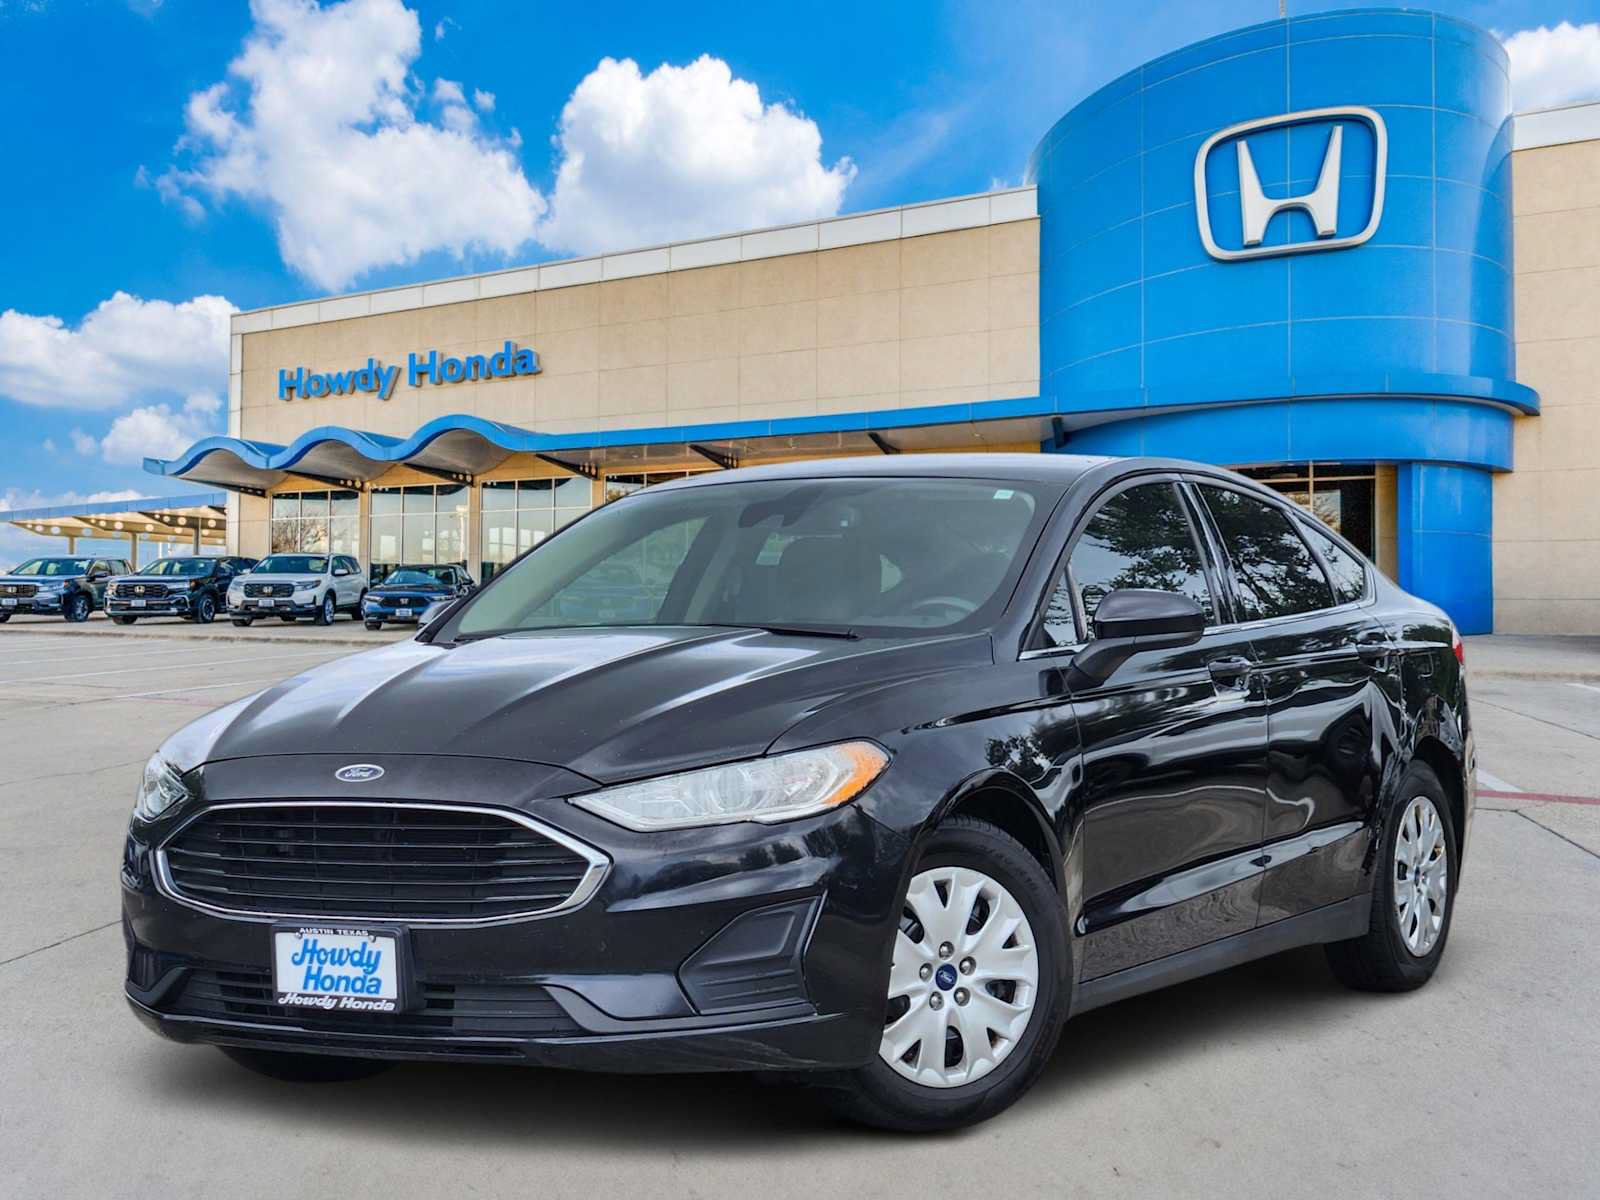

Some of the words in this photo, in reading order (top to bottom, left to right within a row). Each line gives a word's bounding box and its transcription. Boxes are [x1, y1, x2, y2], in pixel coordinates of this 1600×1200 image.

[278, 358, 400, 400] Howdy
[408, 340, 540, 387] Honda
[299, 927, 334, 935] AUSTIN
[291, 938, 382, 975] Howdy
[302, 966, 382, 994] Honda
[278, 992, 338, 1010] Howdy
[339, 997, 395, 1011] Honda
